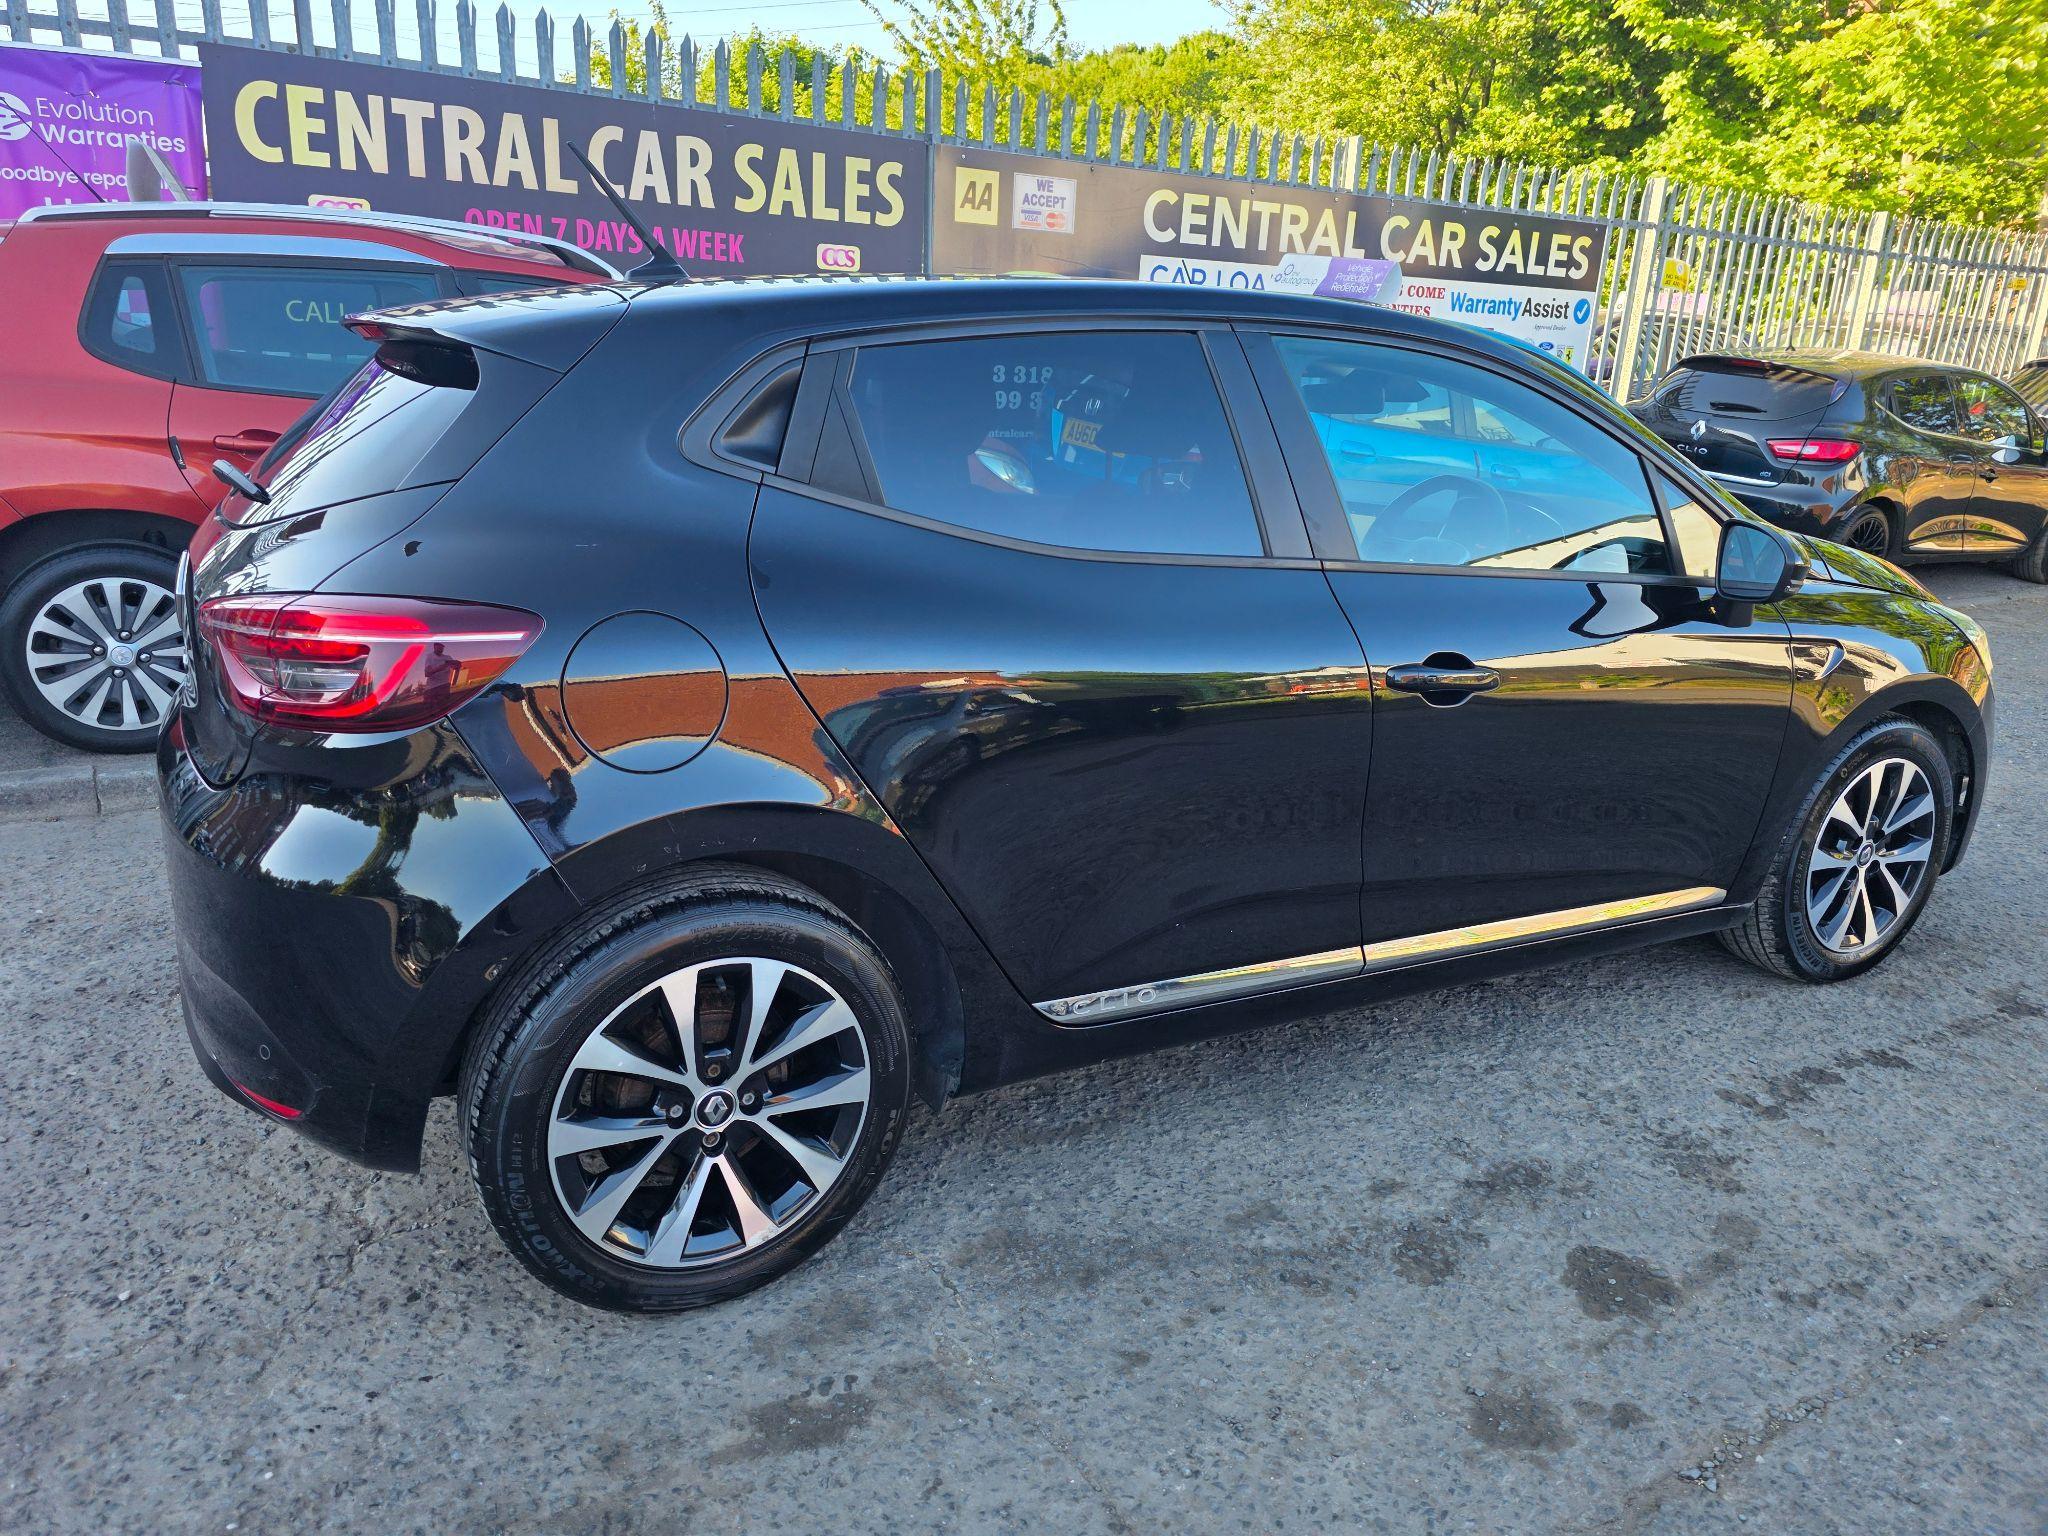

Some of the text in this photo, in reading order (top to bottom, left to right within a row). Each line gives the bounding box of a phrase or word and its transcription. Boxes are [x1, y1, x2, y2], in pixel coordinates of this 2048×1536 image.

[36, 97, 154, 126] Evolution
[39, 122, 186, 153] Warranties
[234, 80, 905, 228] CENTRAL CAR SALES
[0, 165, 79, 187] oodbye
[1037, 179, 1054, 193] WE
[960, 181, 992, 212] AA
[1022, 193, 1066, 209] ACCEPT
[1024, 214, 1039, 222] VISA
[551, 218, 568, 241] 7
[576, 218, 643, 254] DAYS
[672, 228, 745, 263] WEEK
[1143, 189, 1593, 281] CENTRAL CAR SALES
[1330, 282, 1370, 294] Redefined
[1407, 285, 1446, 299] COME
[1450, 291, 1570, 321] WarrantyAssist
[1677, 444, 1708, 455] CLIO
[1073, 987, 1157, 1015] CLIO
